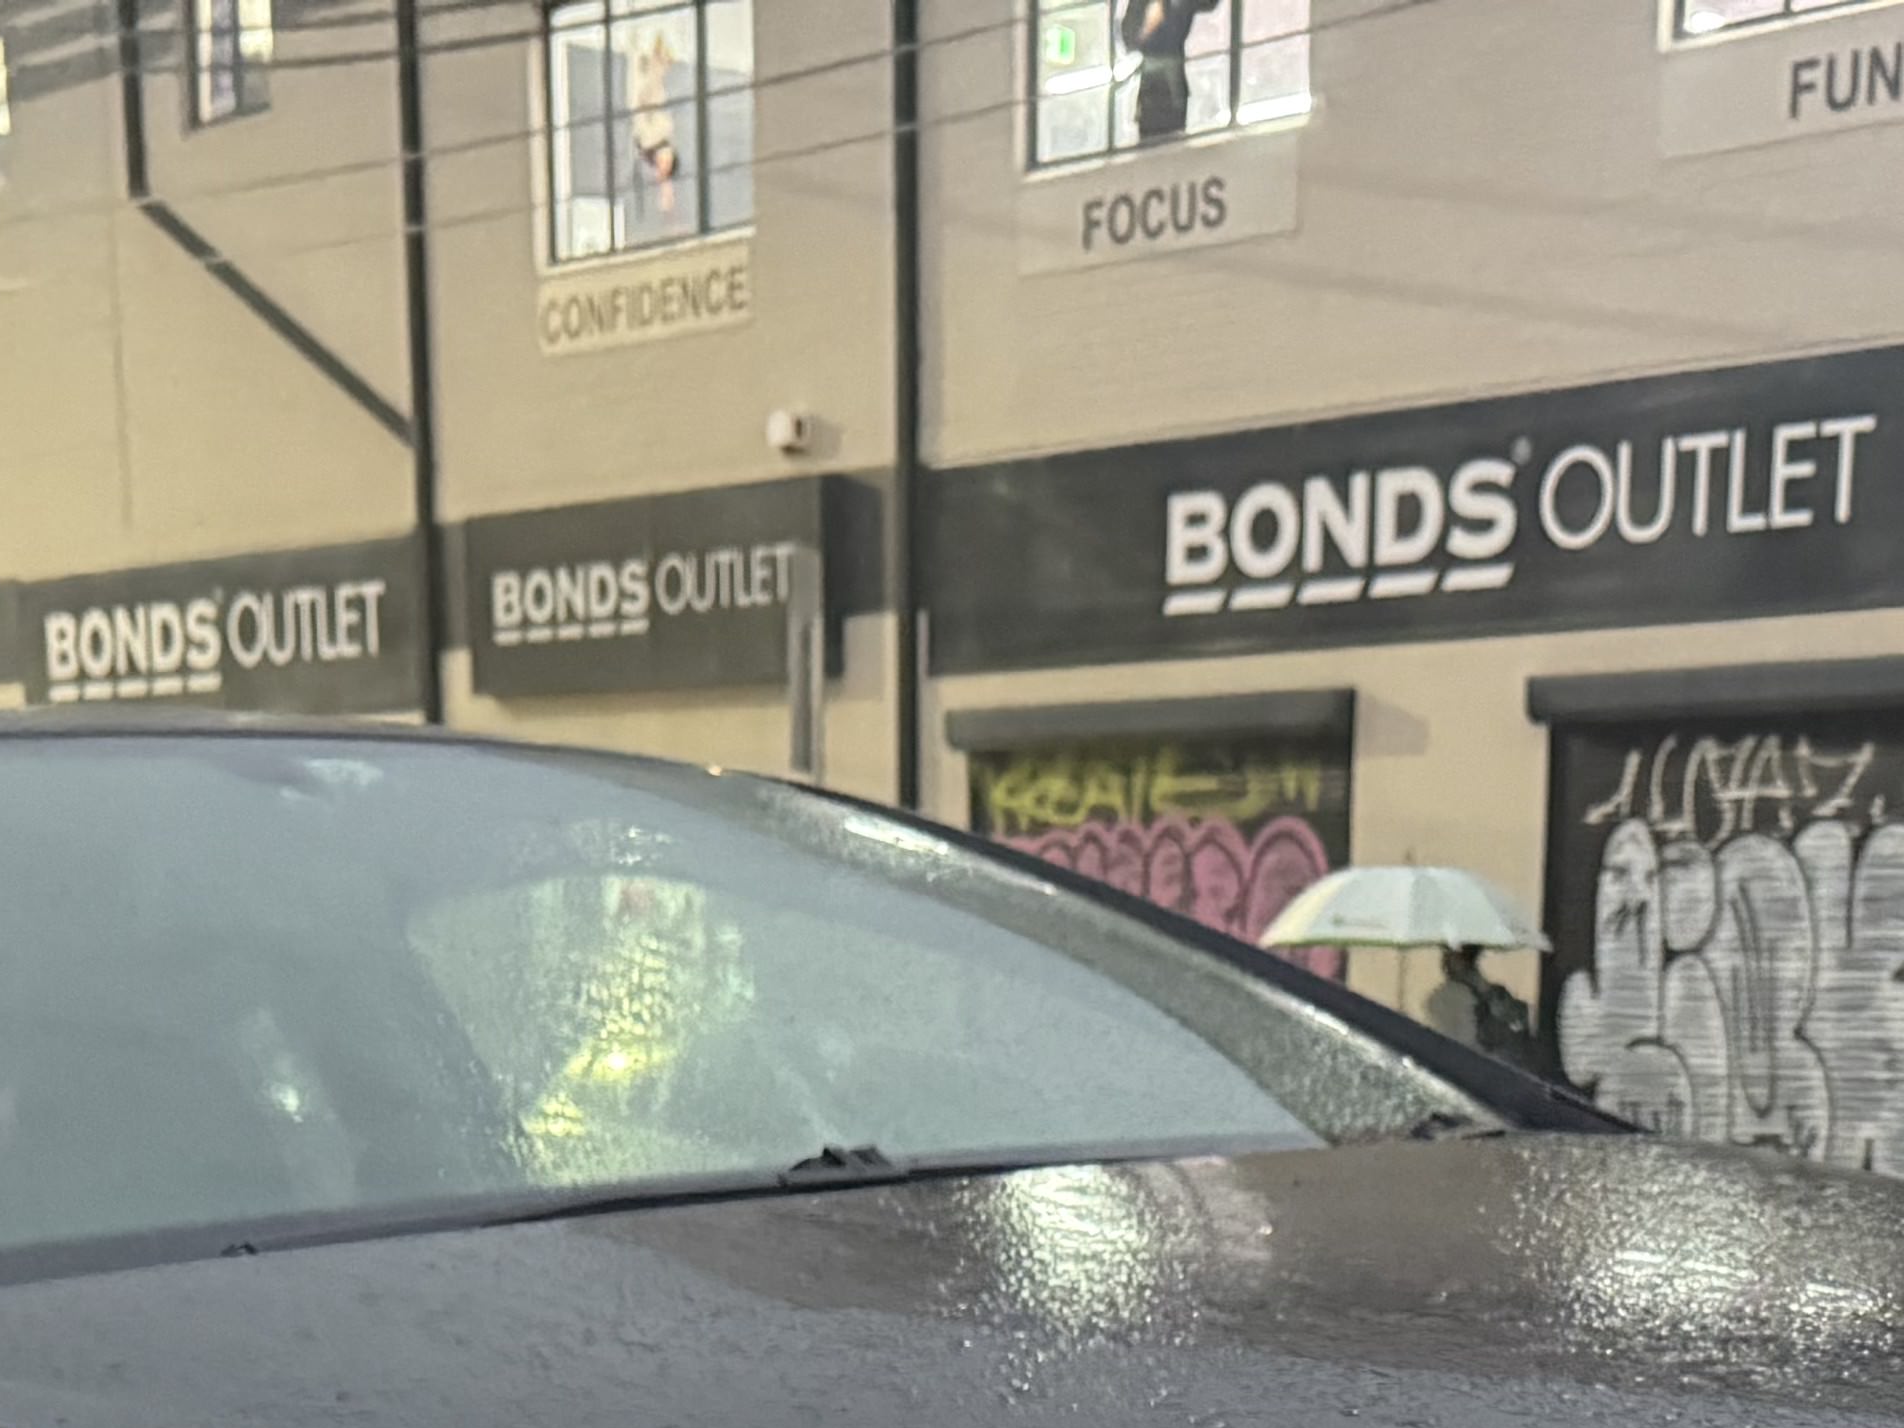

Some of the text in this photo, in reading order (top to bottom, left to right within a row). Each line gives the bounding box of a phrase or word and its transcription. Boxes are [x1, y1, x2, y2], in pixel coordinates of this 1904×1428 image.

[1081, 176, 1227, 252] FOCUS
[543, 264, 749, 347] CONFIDENCE
[1164, 415, 1877, 587] BONDS OUTLET
[493, 542, 793, 629] BONDS OUTLET
[43, 580, 386, 682] BONDS OUTLET
